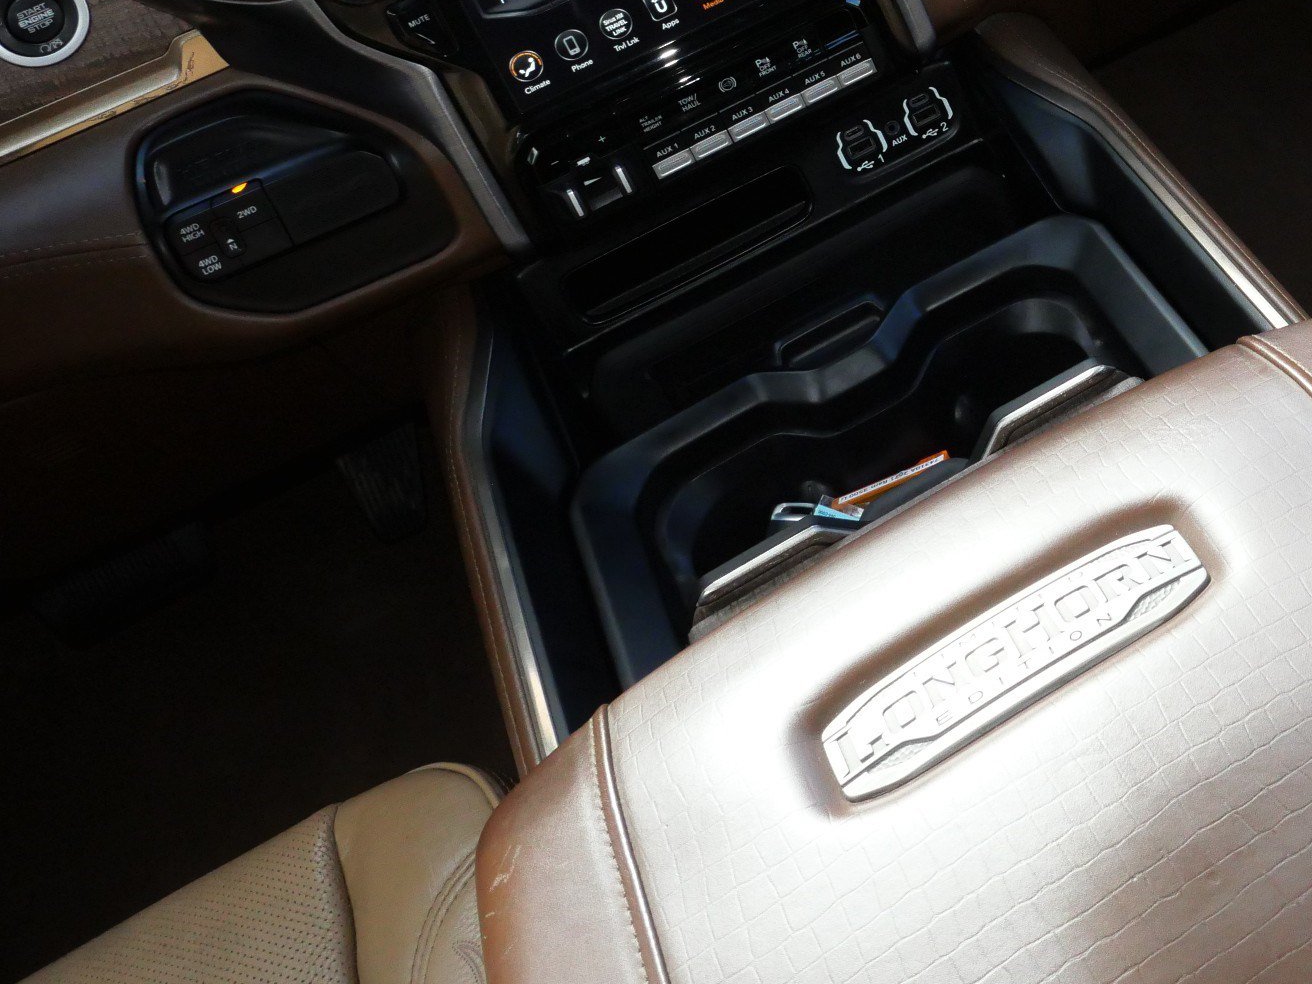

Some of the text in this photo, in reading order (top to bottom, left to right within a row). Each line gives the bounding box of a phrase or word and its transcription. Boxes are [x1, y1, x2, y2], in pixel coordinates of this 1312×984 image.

[16, 2, 46, 19] START
[18, 9, 55, 28] ENGINE
[408, 14, 431, 28] MUTE
[662, 18, 680, 30] Apps
[27, 18, 54, 34] STOP
[605, 19, 628, 32] TRAVEL
[612, 26, 627, 36] LINK
[613, 36, 640, 52] Trvl Lnk
[571, 59, 594, 72] Phone
[840, 52, 862, 68] AUX 6
[759, 65, 777, 77] FRONT
[804, 70, 826, 86] AUX 5
[524, 79, 551, 95] Climate
[768, 91, 784, 102] AUX
[682, 101, 702, 112] HAUL
[732, 110, 748, 121] AUX
[940, 122, 949, 132] 2
[694, 128, 710, 140] AUX
[892, 134, 908, 147] AUX
[656, 146, 673, 158] AUX
[878, 154, 884, 163] 1
[236, 205, 258, 219] 2WD
[180, 222, 200, 235] 4WD
[182, 230, 205, 243] HIGH
[229, 242, 238, 250] N
[198, 254, 218, 268] 4WD
[202, 262, 222, 276] LOW
[829, 537, 1192, 780] LONGHORN
[935, 612, 1113, 727] EDITION
